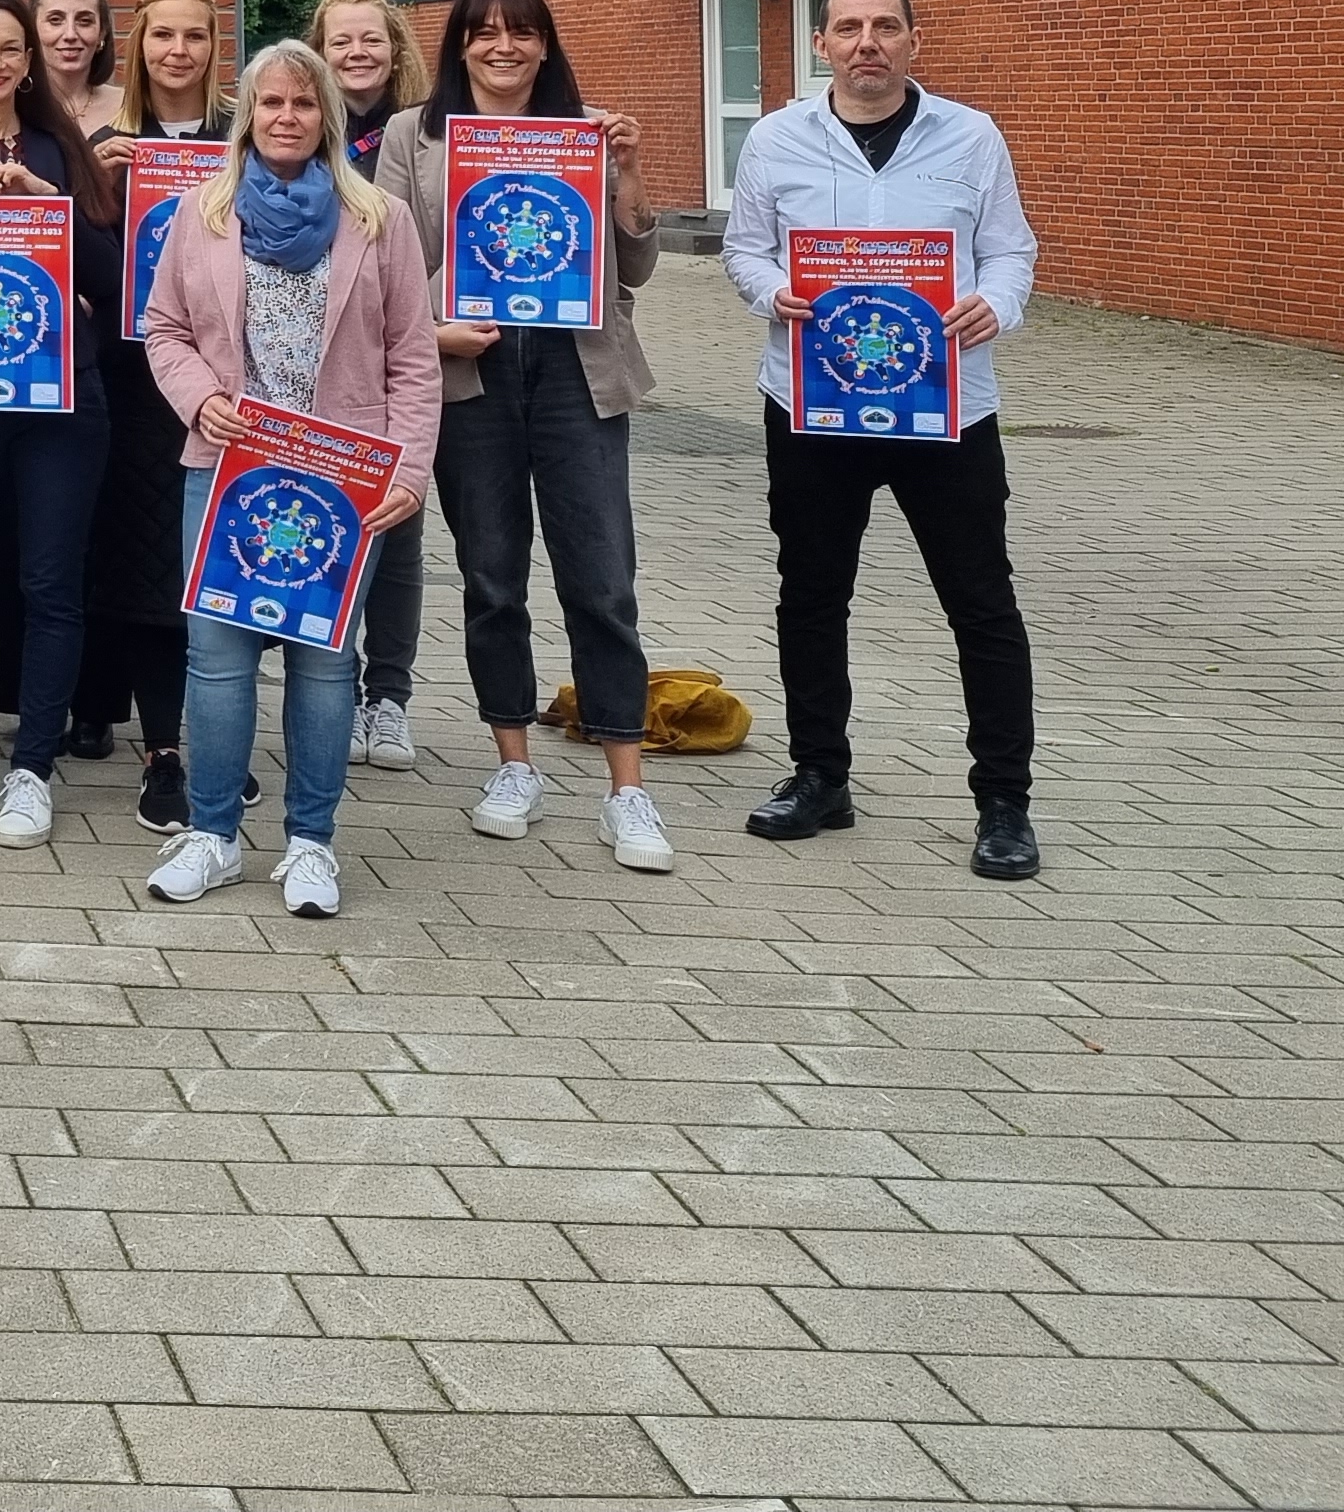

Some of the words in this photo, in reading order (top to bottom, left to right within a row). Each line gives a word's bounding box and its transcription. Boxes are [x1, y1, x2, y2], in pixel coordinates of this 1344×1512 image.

[523, 147, 572, 155] SEPTEMBER
[869, 258, 921, 266] SEPTEMBER
[308, 448, 361, 469] SEPTEMBER
